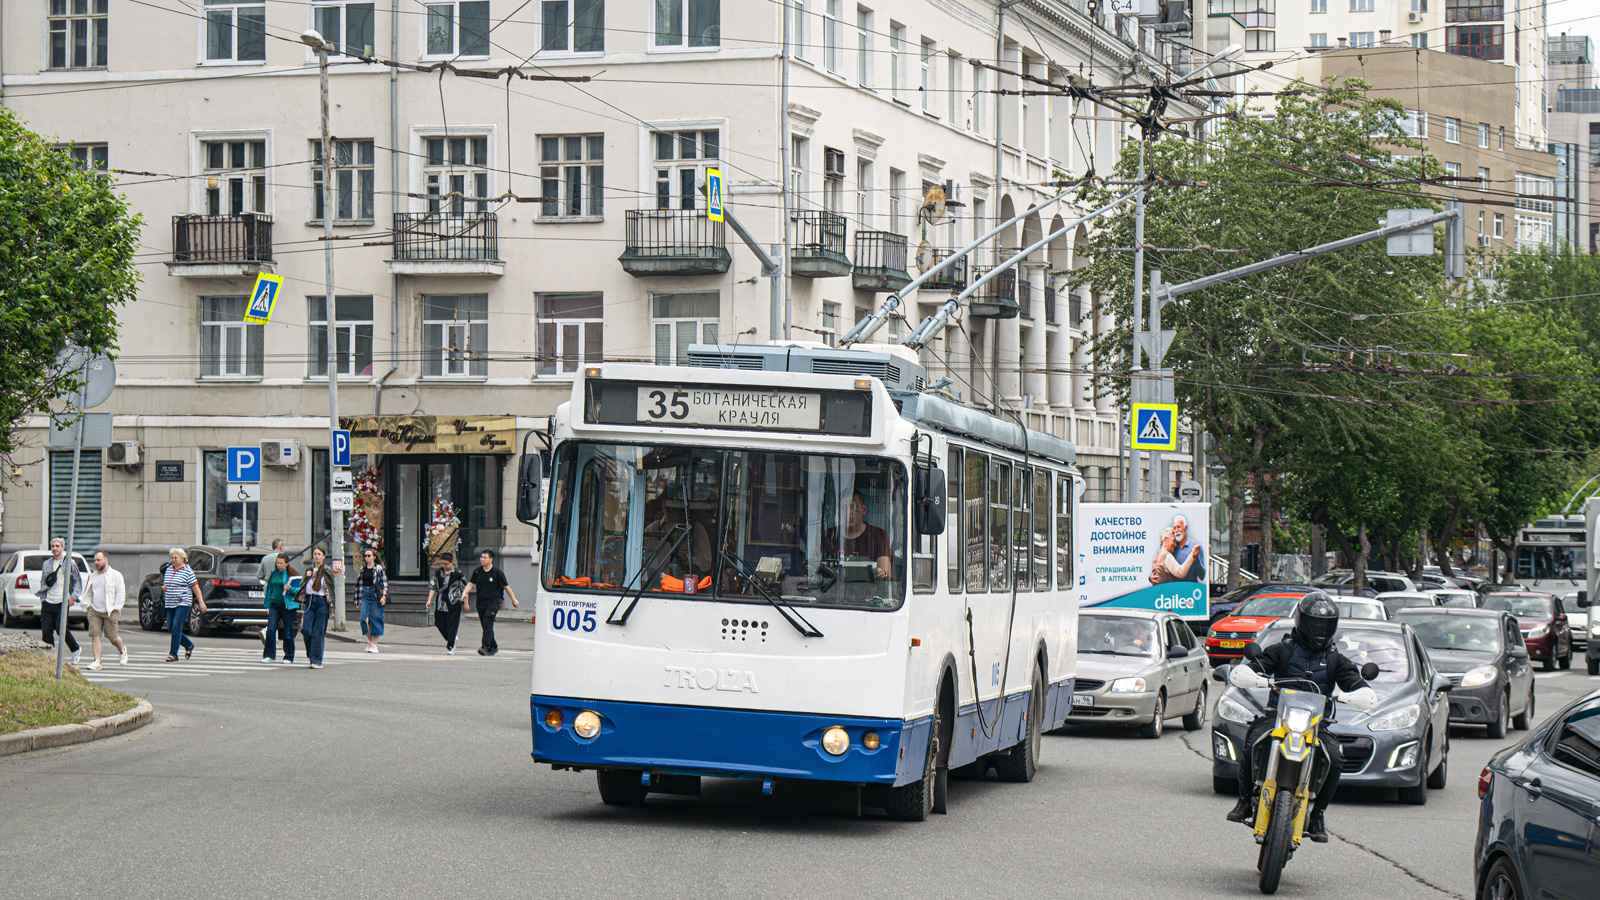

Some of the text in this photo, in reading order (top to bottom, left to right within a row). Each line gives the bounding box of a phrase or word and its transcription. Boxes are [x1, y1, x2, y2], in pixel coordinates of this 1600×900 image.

[648, 390, 690, 420] 35
[693, 391, 807, 410] БОТАНИЧЕСКАЯ
[718, 409, 780, 425] КРАУЛЯ
[336, 433, 347, 463] P
[237, 450, 255, 479] P
[343, 496, 351, 505] 20
[1094, 517, 1142, 526] КАЧЕСТВО
[1090, 530, 1147, 542] ДОСТОЙНОЕ
[1093, 545, 1145, 555] ВНИМАНИЯ
[1095, 565, 1143, 574] СПРАШИВАЙТЕ
[553, 599, 597, 609] ЕМУП ГОРТРАНС
[552, 607, 597, 633] 005
[663, 665, 759, 693] TROLZA
